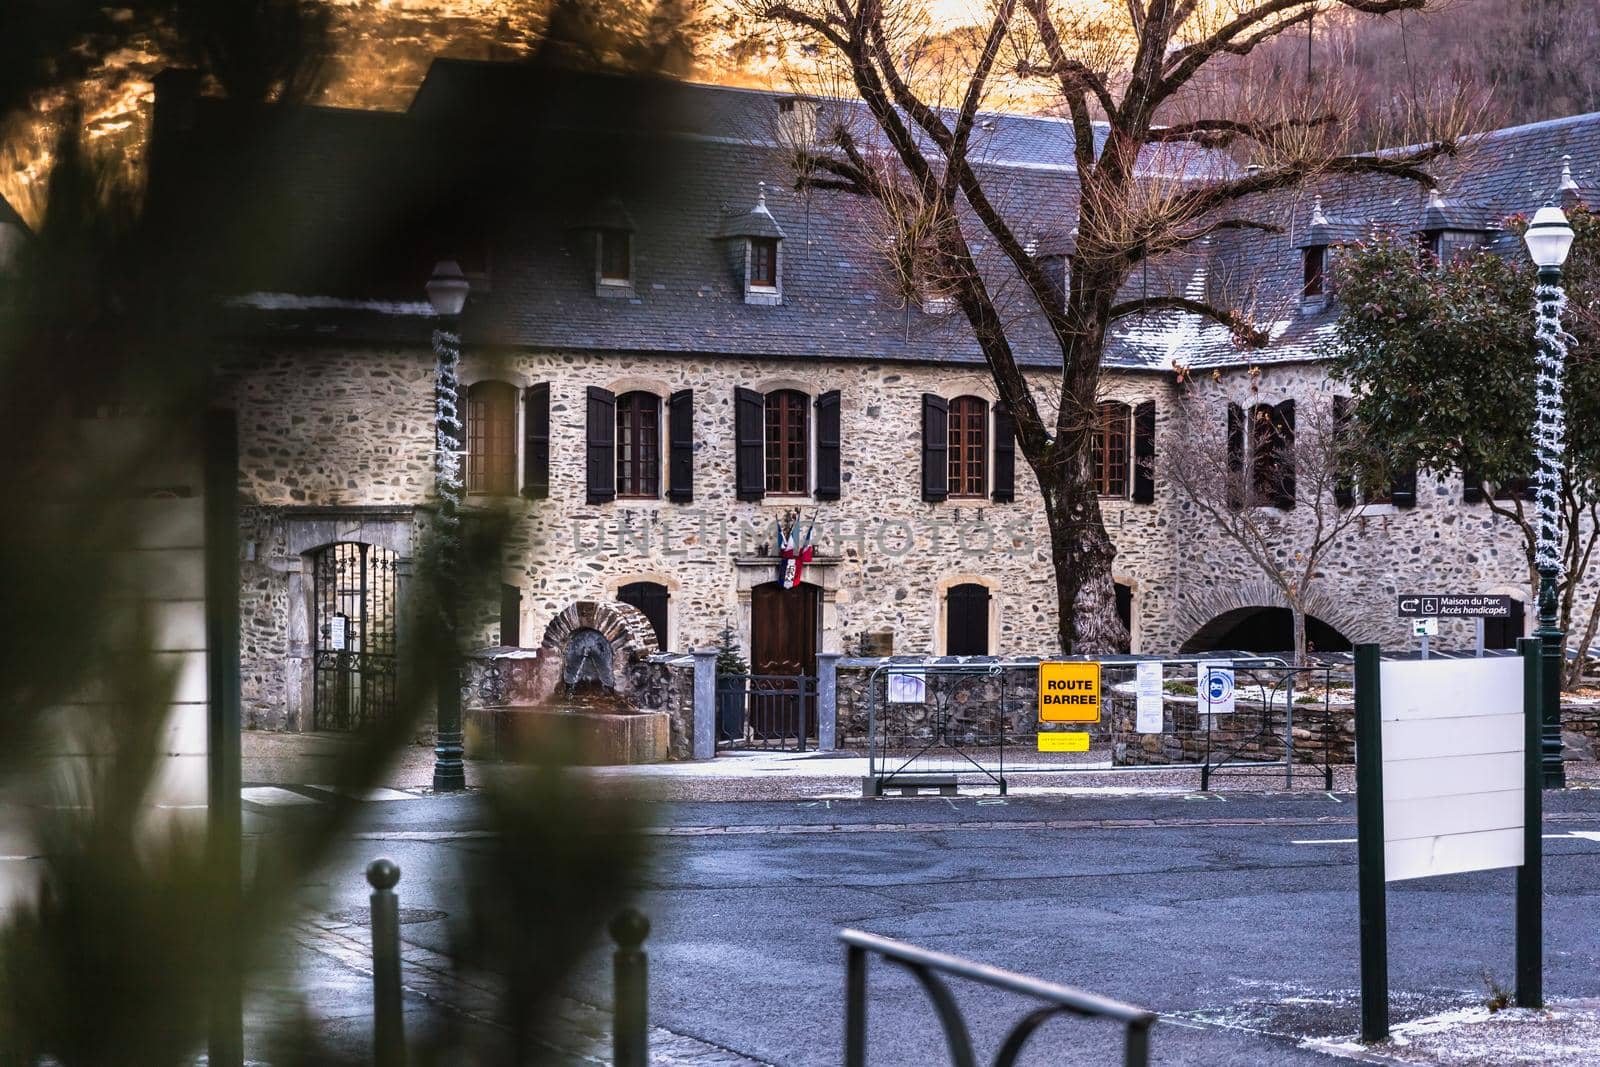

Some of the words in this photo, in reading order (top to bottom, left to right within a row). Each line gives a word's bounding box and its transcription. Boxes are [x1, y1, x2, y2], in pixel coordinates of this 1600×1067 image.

[1440, 597, 1469, 605] Maison
[1471, 597, 1482, 605] du
[1483, 597, 1500, 605] Parc
[1440, 606, 1461, 614] Accès
[1463, 606, 1507, 616] handicapés
[1048, 680, 1093, 690] ROUTE
[1043, 695, 1097, 705] BARREE
